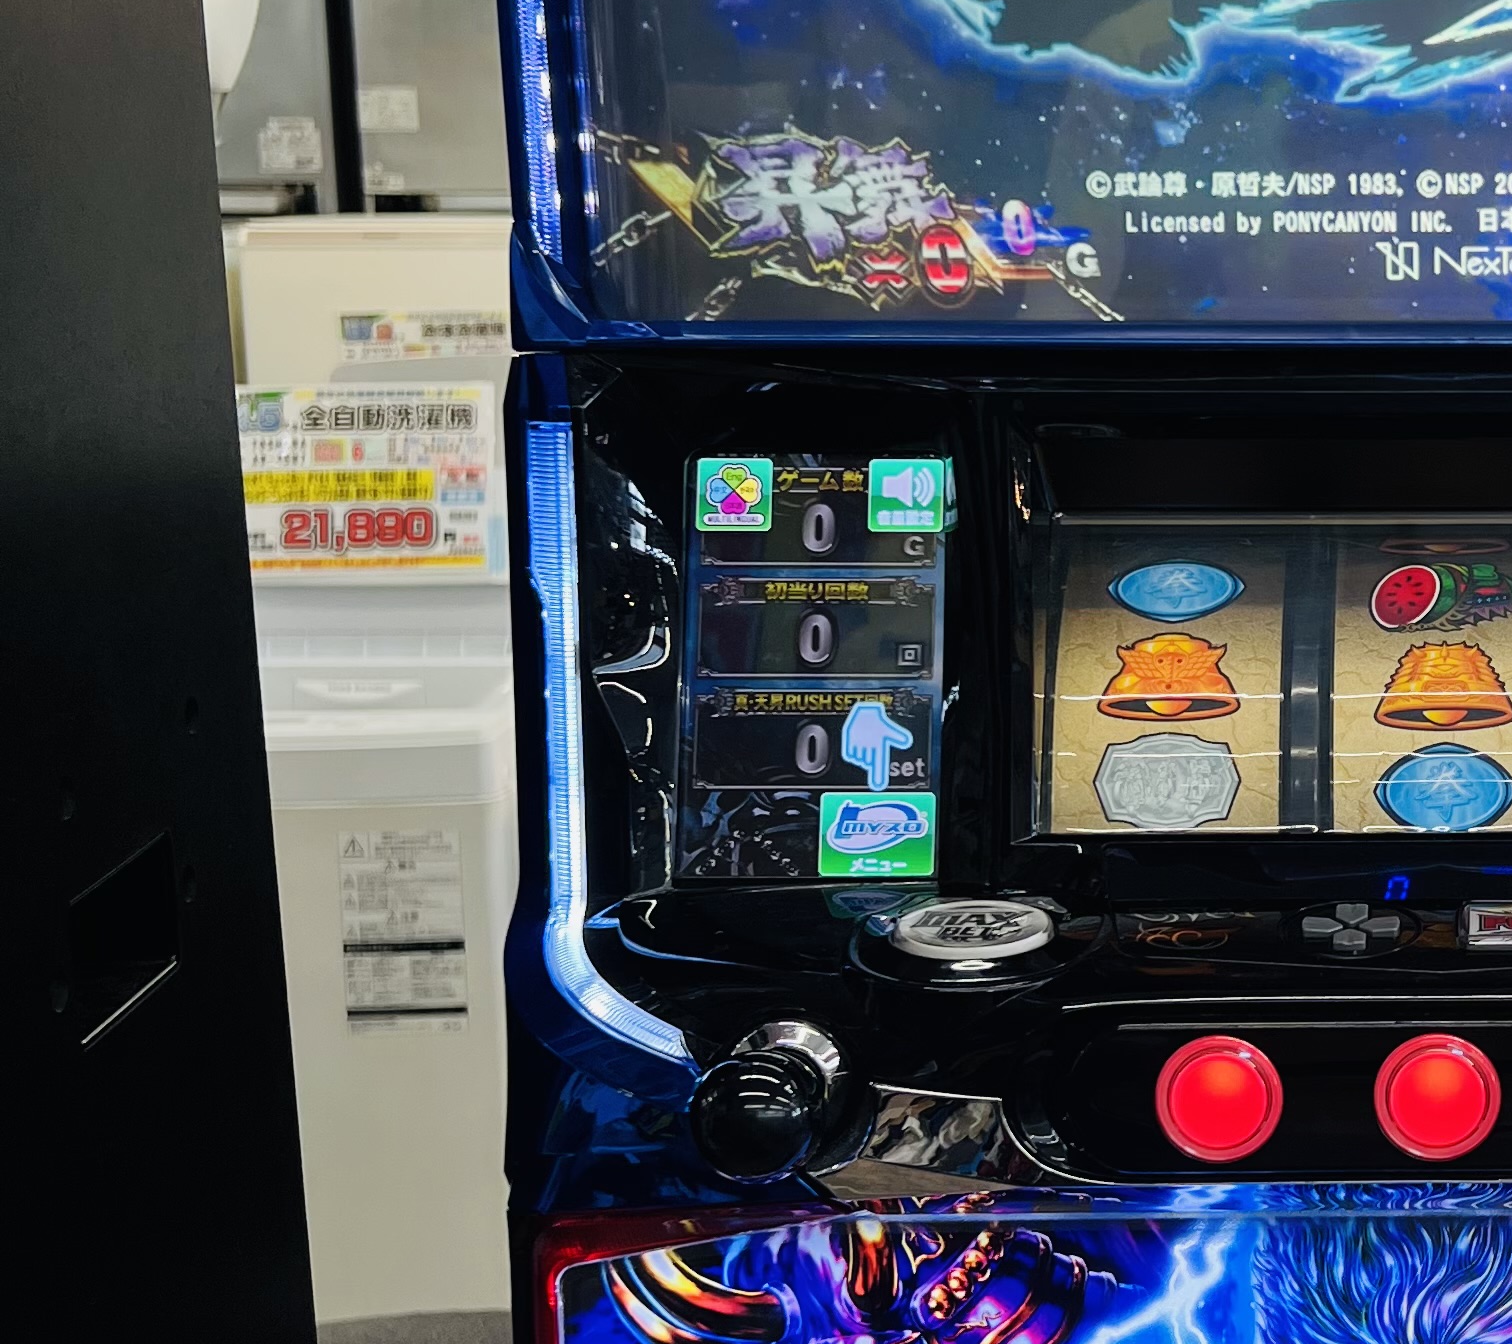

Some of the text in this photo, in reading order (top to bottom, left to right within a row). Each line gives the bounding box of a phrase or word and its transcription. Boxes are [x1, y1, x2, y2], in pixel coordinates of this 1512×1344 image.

[1125, 210, 1226, 234] Licensed
[1236, 210, 1262, 236] by
[1273, 210, 1398, 234] PONYCANYON
[1411, 210, 1453, 234] INC.
[1066, 243, 1102, 278] G
[302, 404, 475, 432] 全自動洗濯機
[777, 470, 864, 492] ゲーム数
[803, 503, 925, 556] 0 G
[764, 581, 869, 601] 初当り回数
[799, 613, 833, 663] 0
[795, 724, 925, 778] 0 set
[850, 857, 907, 873] メニュー
